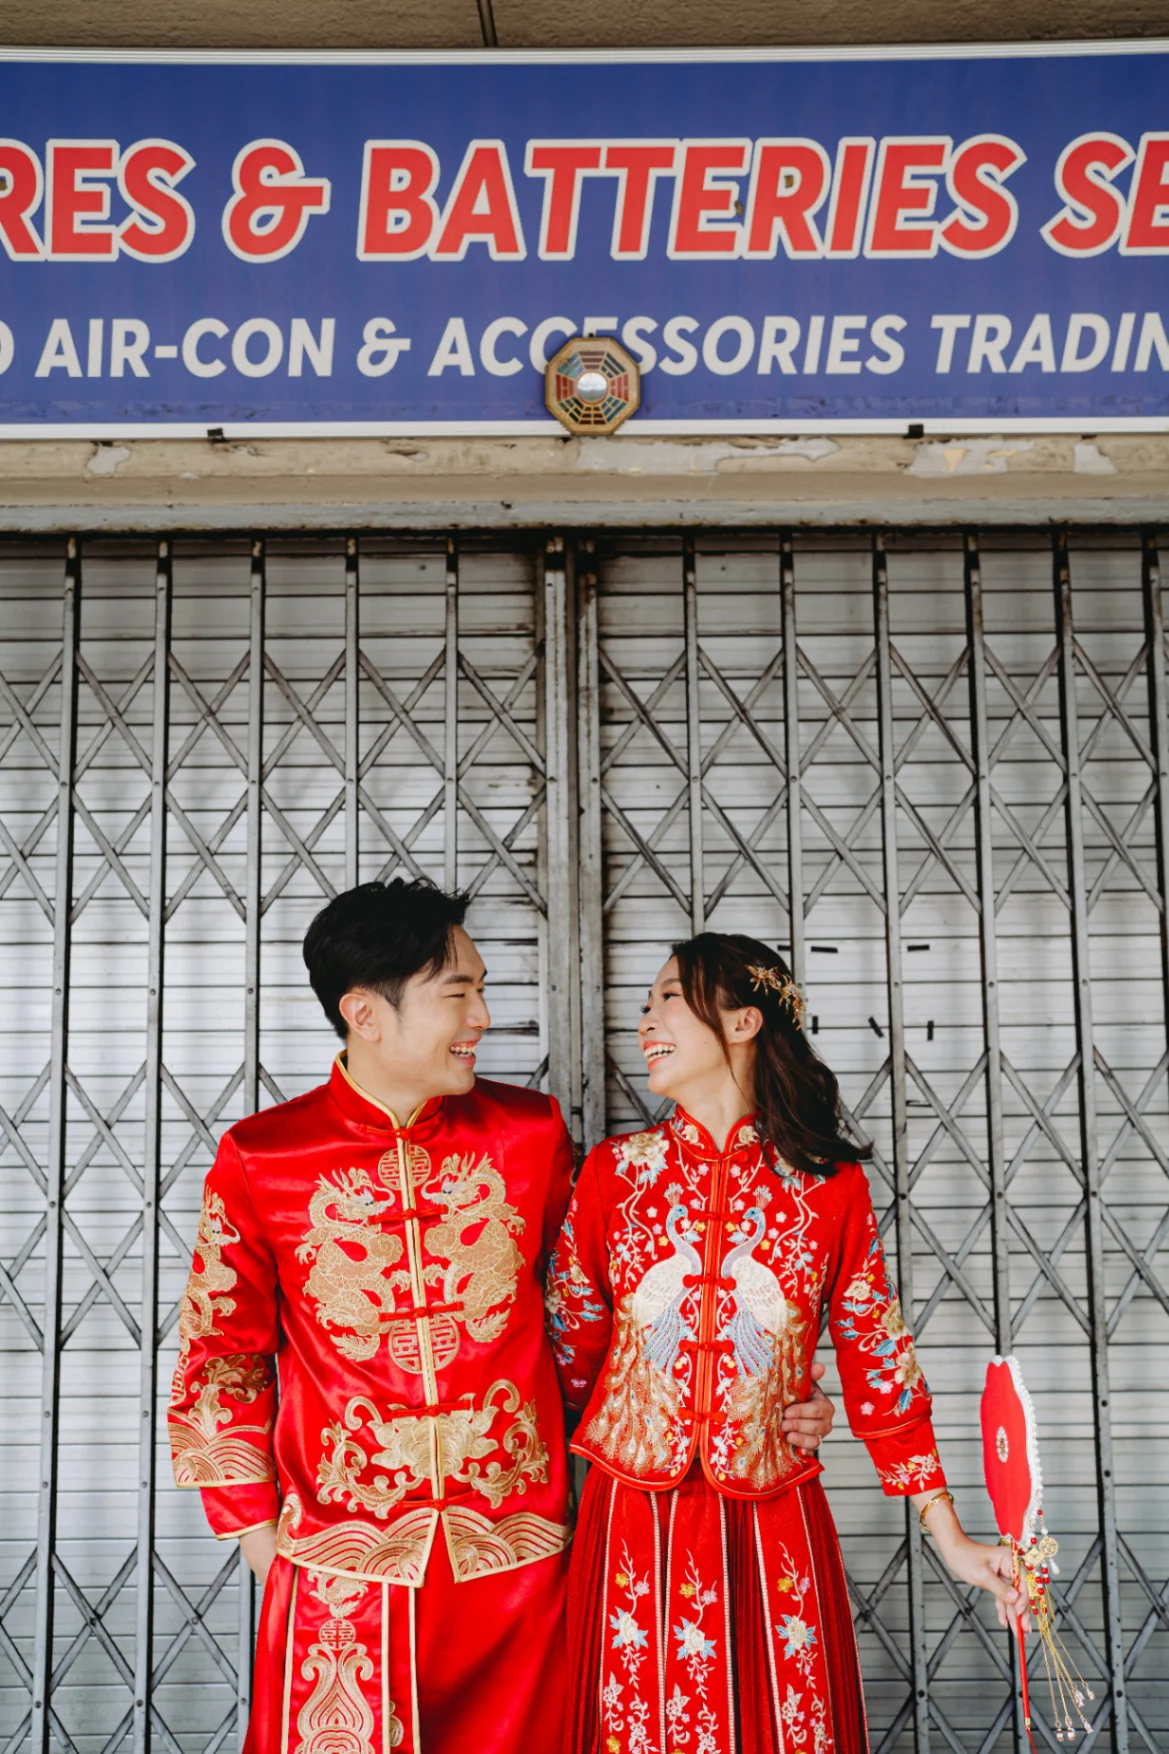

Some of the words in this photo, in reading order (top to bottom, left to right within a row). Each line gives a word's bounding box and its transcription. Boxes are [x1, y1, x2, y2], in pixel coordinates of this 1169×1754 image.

[222, 139, 331, 263] &
[356, 134, 1027, 261] BATTERIES
[35, 318, 335, 378] AIR-CON
[357, 317, 411, 377] &
[931, 312, 1169, 374] TRADIN
